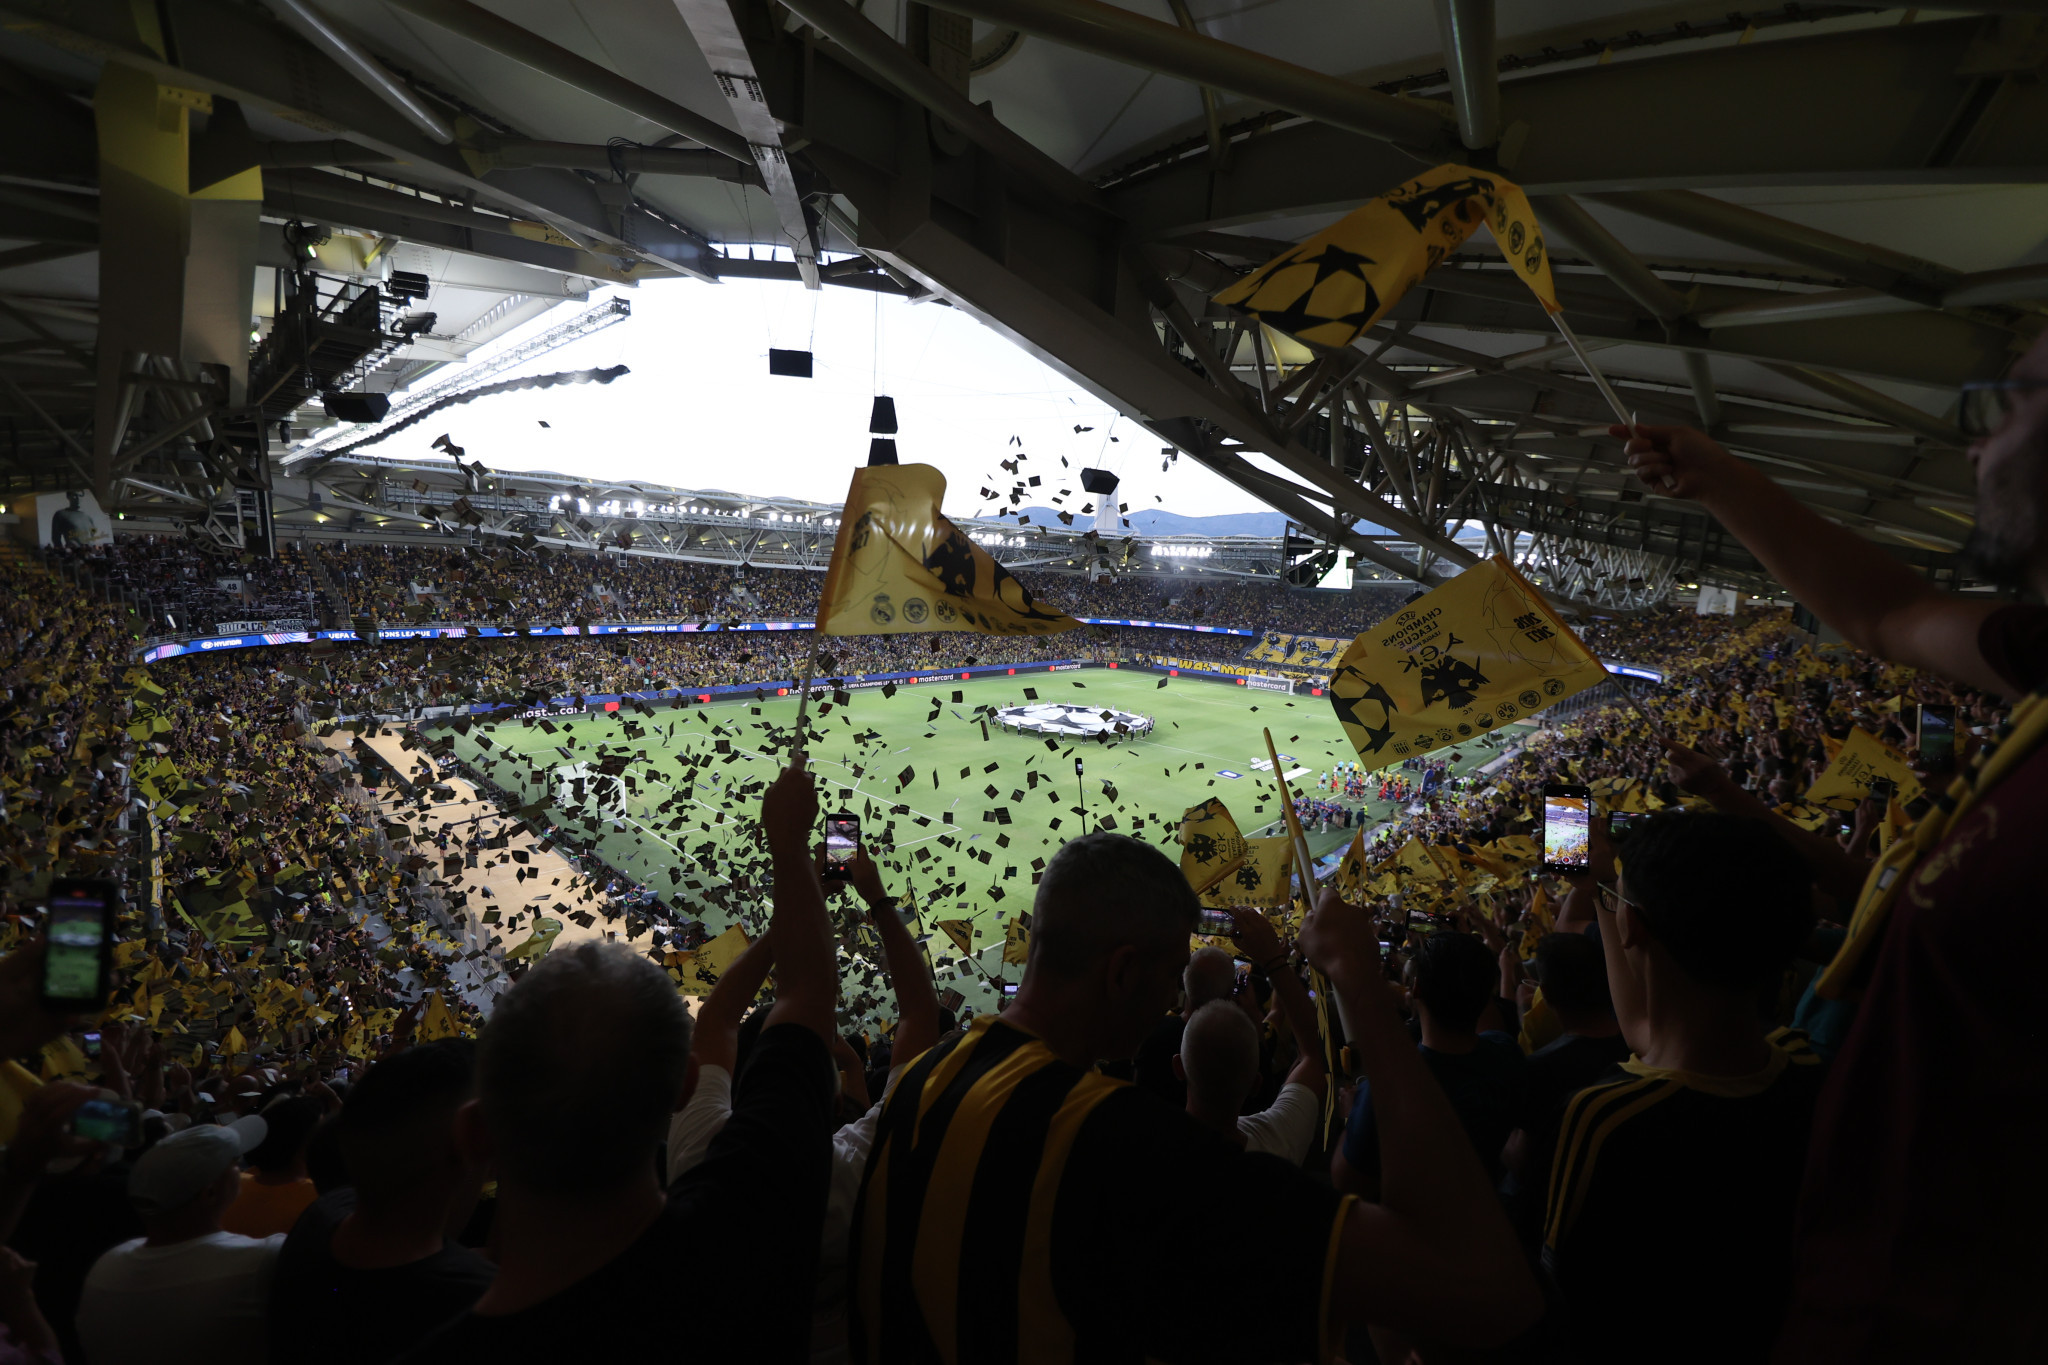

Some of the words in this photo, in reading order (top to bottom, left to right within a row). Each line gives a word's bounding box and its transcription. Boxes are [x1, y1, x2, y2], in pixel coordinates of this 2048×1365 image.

[226, 583, 238, 591] 48
[937, 601, 956, 616] BVB
[328, 632, 350, 640] UEFA
[213, 639, 242, 648] HYUNDAI
[1055, 663, 1081, 671] mastercard
[919, 673, 954, 683] mastercard
[1246, 680, 1287, 691] mastercard
